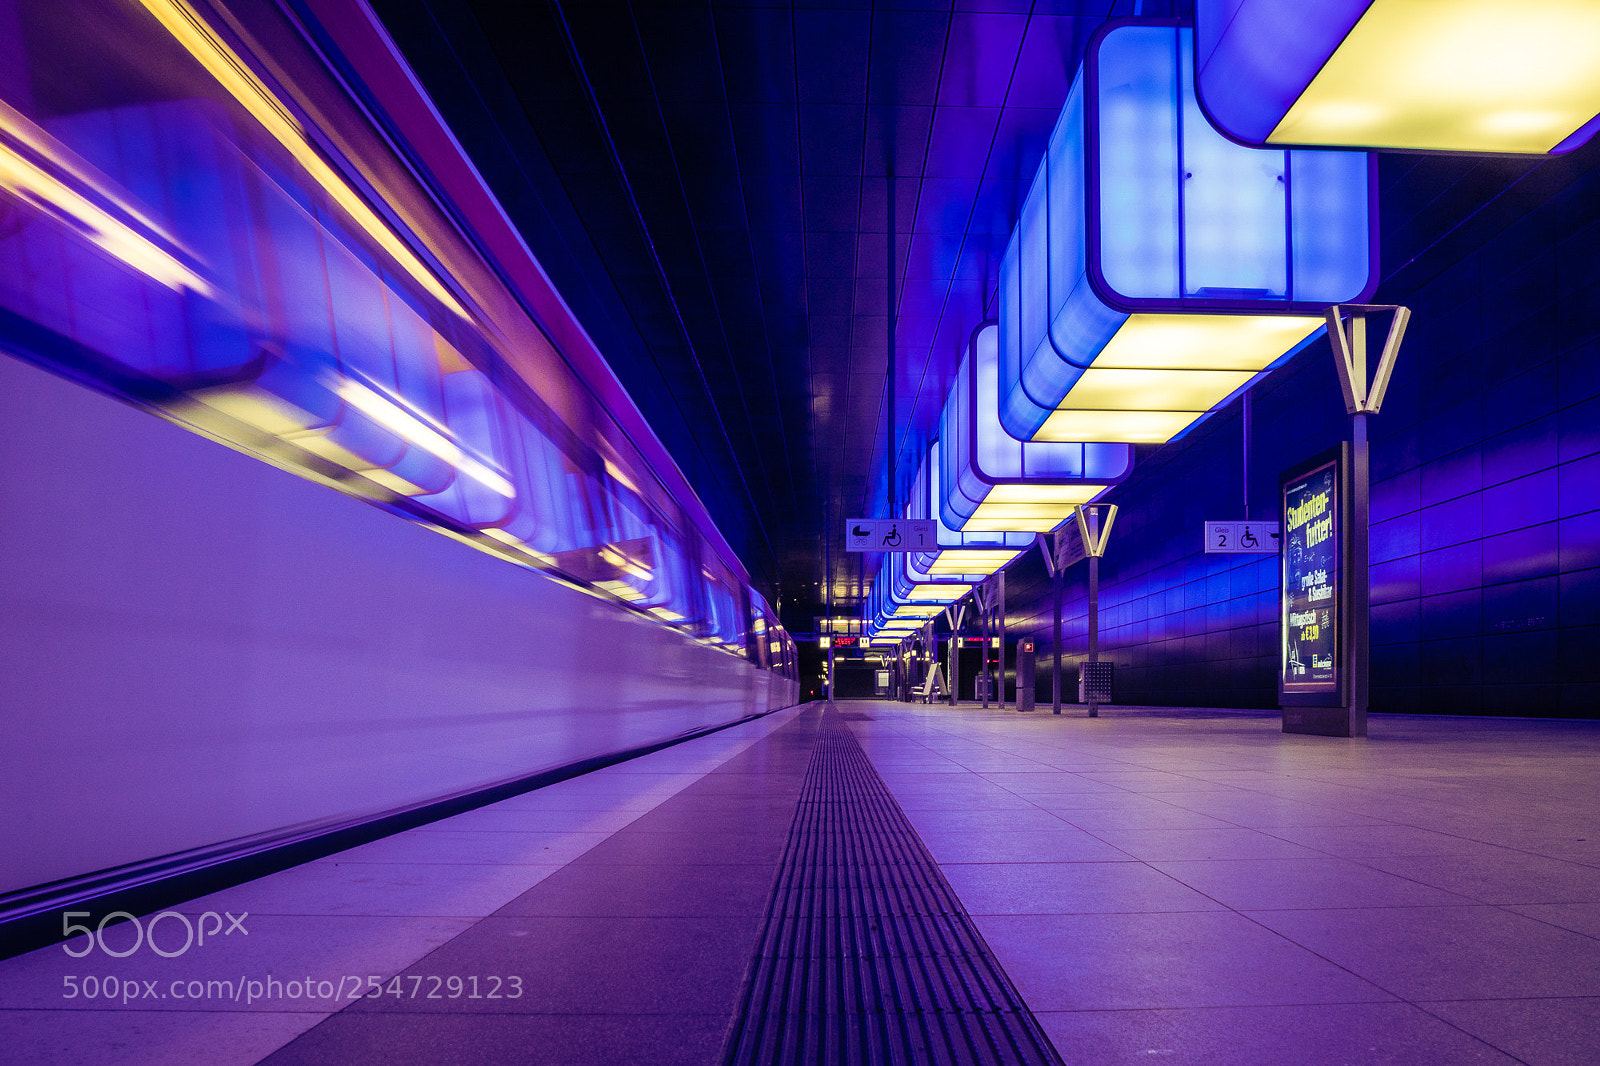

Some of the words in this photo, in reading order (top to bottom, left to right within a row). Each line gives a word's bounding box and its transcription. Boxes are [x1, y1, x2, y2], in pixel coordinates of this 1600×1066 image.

[1287, 491, 1330, 533] Studenten-
[913, 525, 929, 533] Gleis
[1305, 510, 1333, 549] futter!
[918, 533, 924, 546] 1
[1218, 535, 1227, 547] 2
